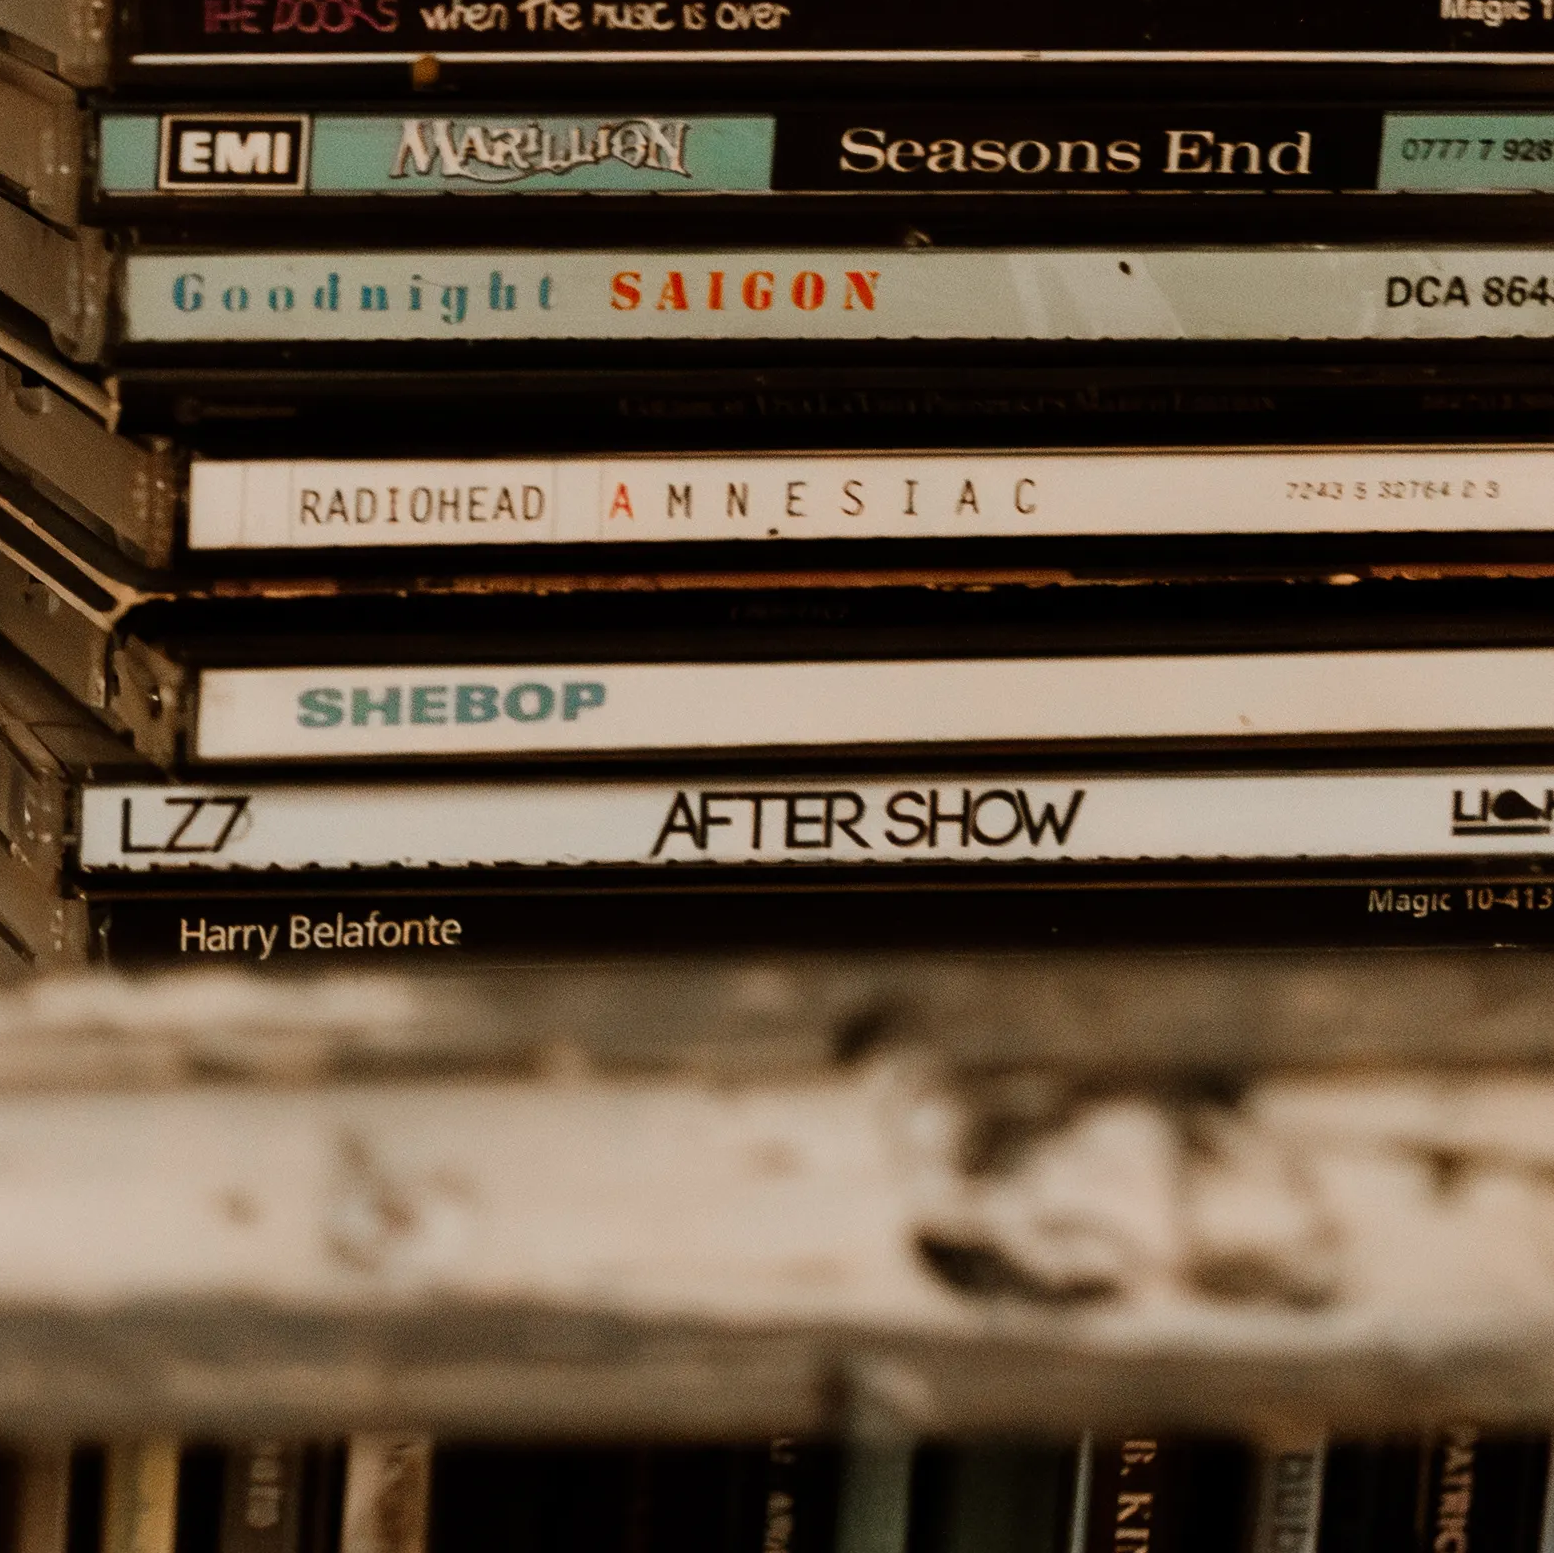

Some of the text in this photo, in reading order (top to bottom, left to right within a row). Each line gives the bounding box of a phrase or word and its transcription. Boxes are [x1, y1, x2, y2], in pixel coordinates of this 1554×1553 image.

[715, 2, 791, 33] over
[179, 131, 289, 174] EMI
[839, 126, 1142, 175] Seasons
[1162, 129, 1313, 175] End
[172, 271, 557, 325] Goodnight
[609, 270, 882, 313] SAIGON
[1386, 275, 1469, 309] DCA
[299, 482, 547, 527] RADIOHEAD
[609, 477, 1040, 520] AMNESIAC
[295, 681, 607, 729] SHEBOP
[650, 790, 873, 857] AFTER
[884, 788, 1085, 849] SHOW
[179, 917, 278, 961] Harry
[289, 911, 462, 950] Belafonte
[1367, 888, 1452, 918] Magic
